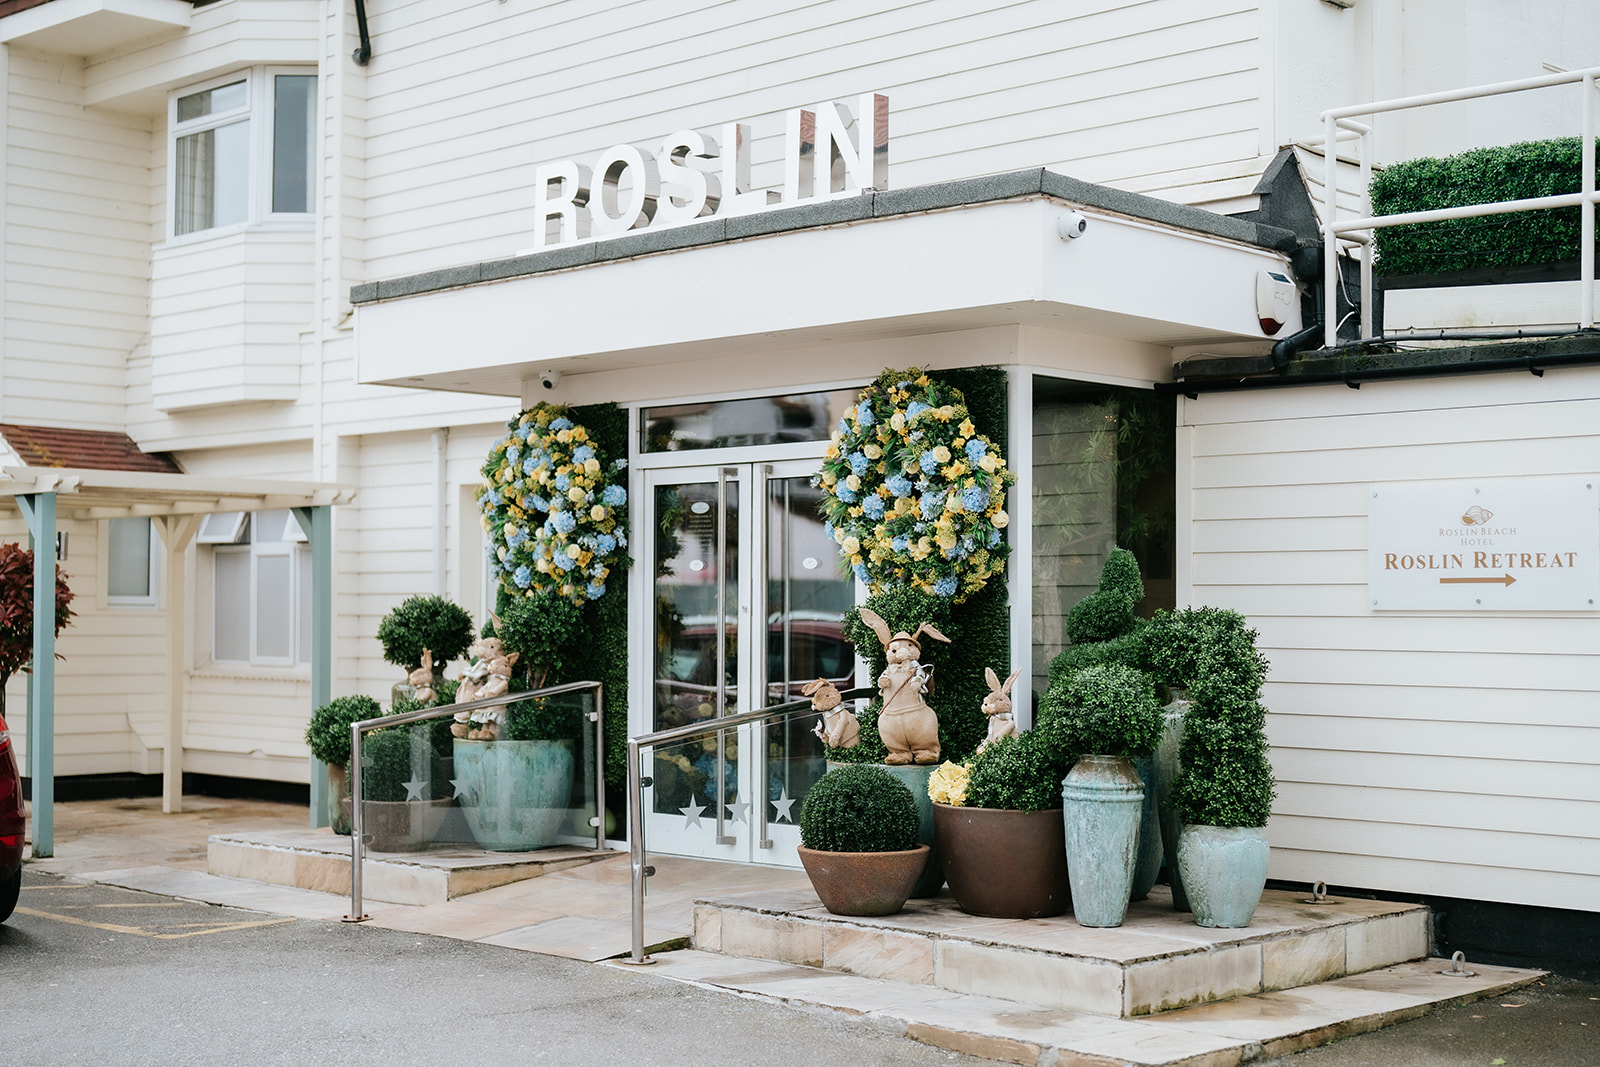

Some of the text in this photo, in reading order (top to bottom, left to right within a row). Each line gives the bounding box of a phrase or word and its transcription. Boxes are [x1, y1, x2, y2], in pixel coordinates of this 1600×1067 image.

[534, 93, 890, 247] ROSLIN
[1439, 527, 1517, 537] ROSLIN BEACH
[1460, 538, 1494, 546] HOTEL
[1384, 551, 1578, 570] ROSLIN RETREAT
